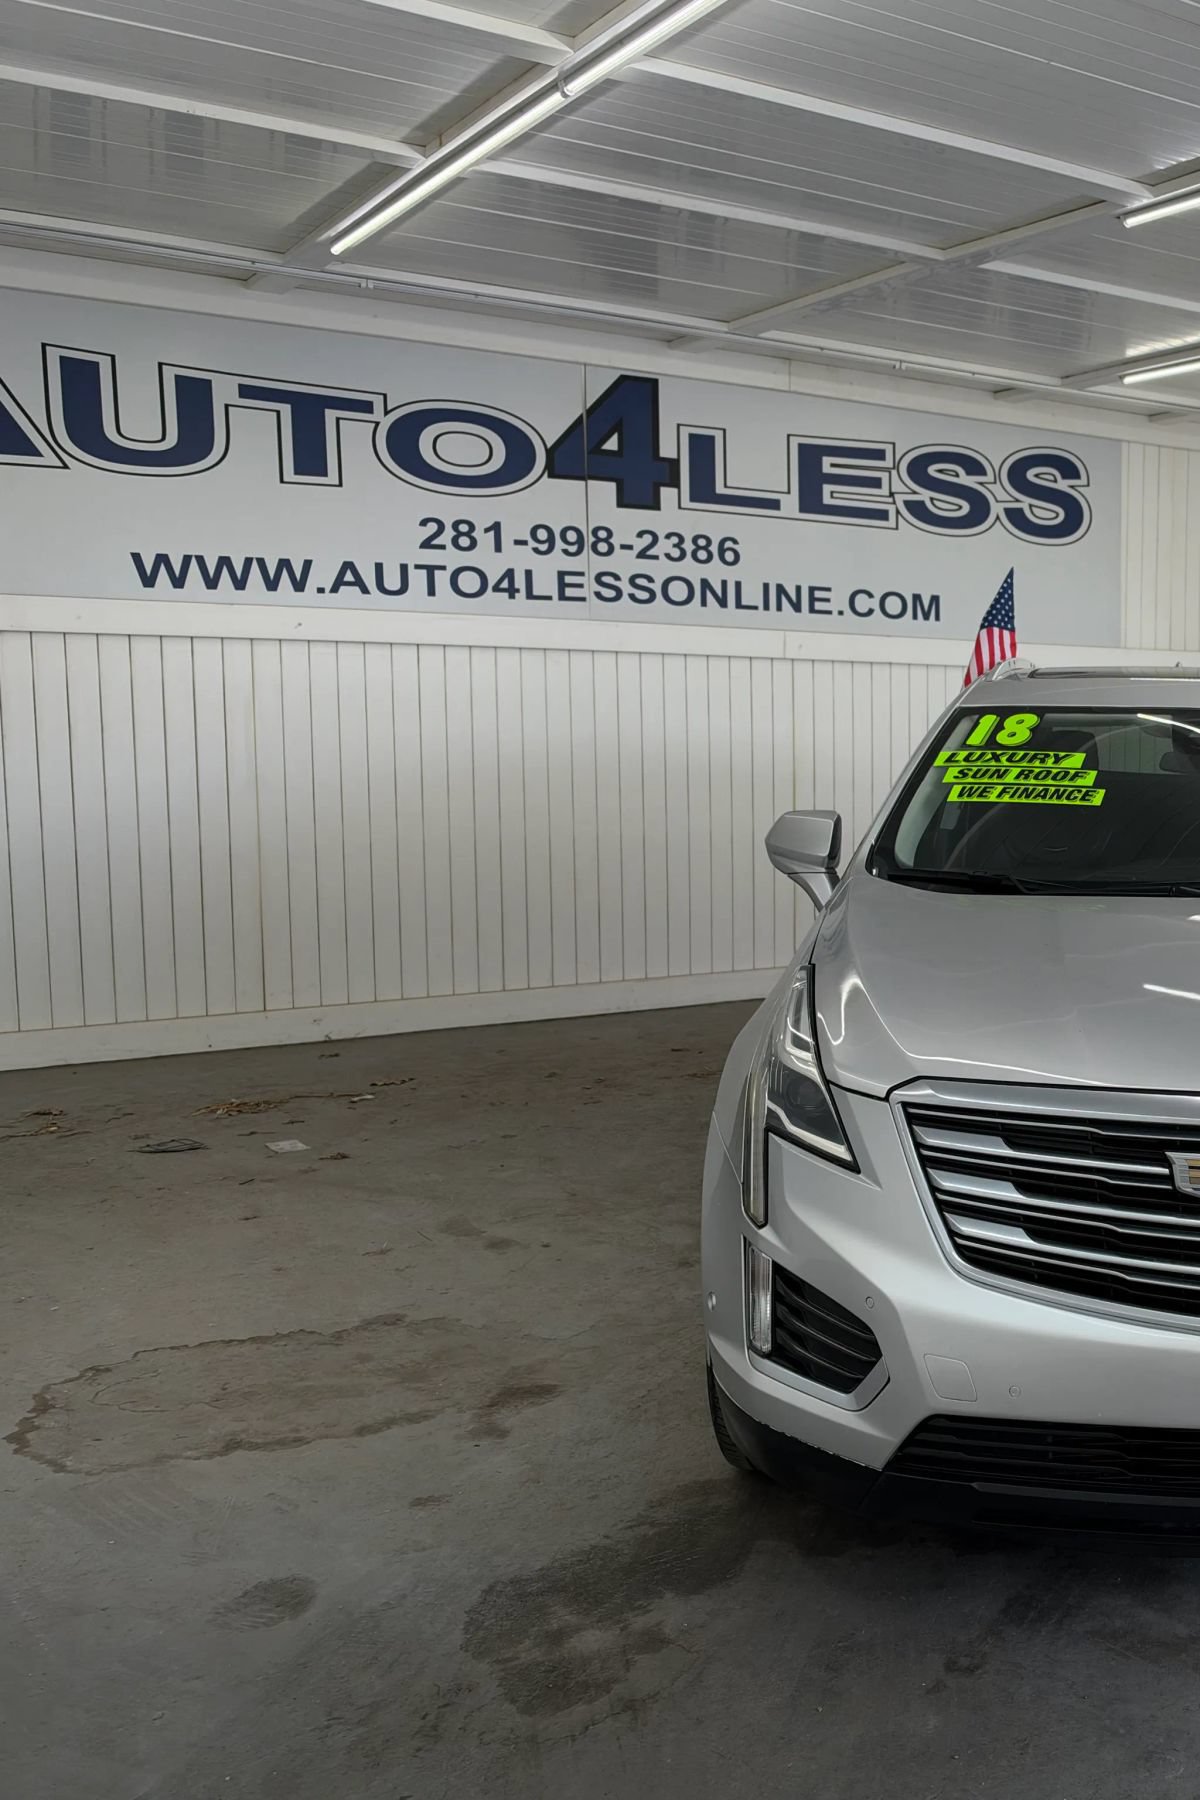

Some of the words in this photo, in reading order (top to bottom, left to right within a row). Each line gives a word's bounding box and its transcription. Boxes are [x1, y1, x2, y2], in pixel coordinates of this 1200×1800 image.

[418, 516, 741, 566] 281-998-2386
[130, 552, 941, 622] WWW.AUTO4LESSONLINE.COM
[965, 713, 1040, 747] 18
[943, 751, 1075, 766] LUXURY
[953, 767, 1008, 782] SUN
[1013, 769, 1089, 784] ROOF
[958, 785, 998, 799] WE
[996, 787, 1099, 803] FINANCE
